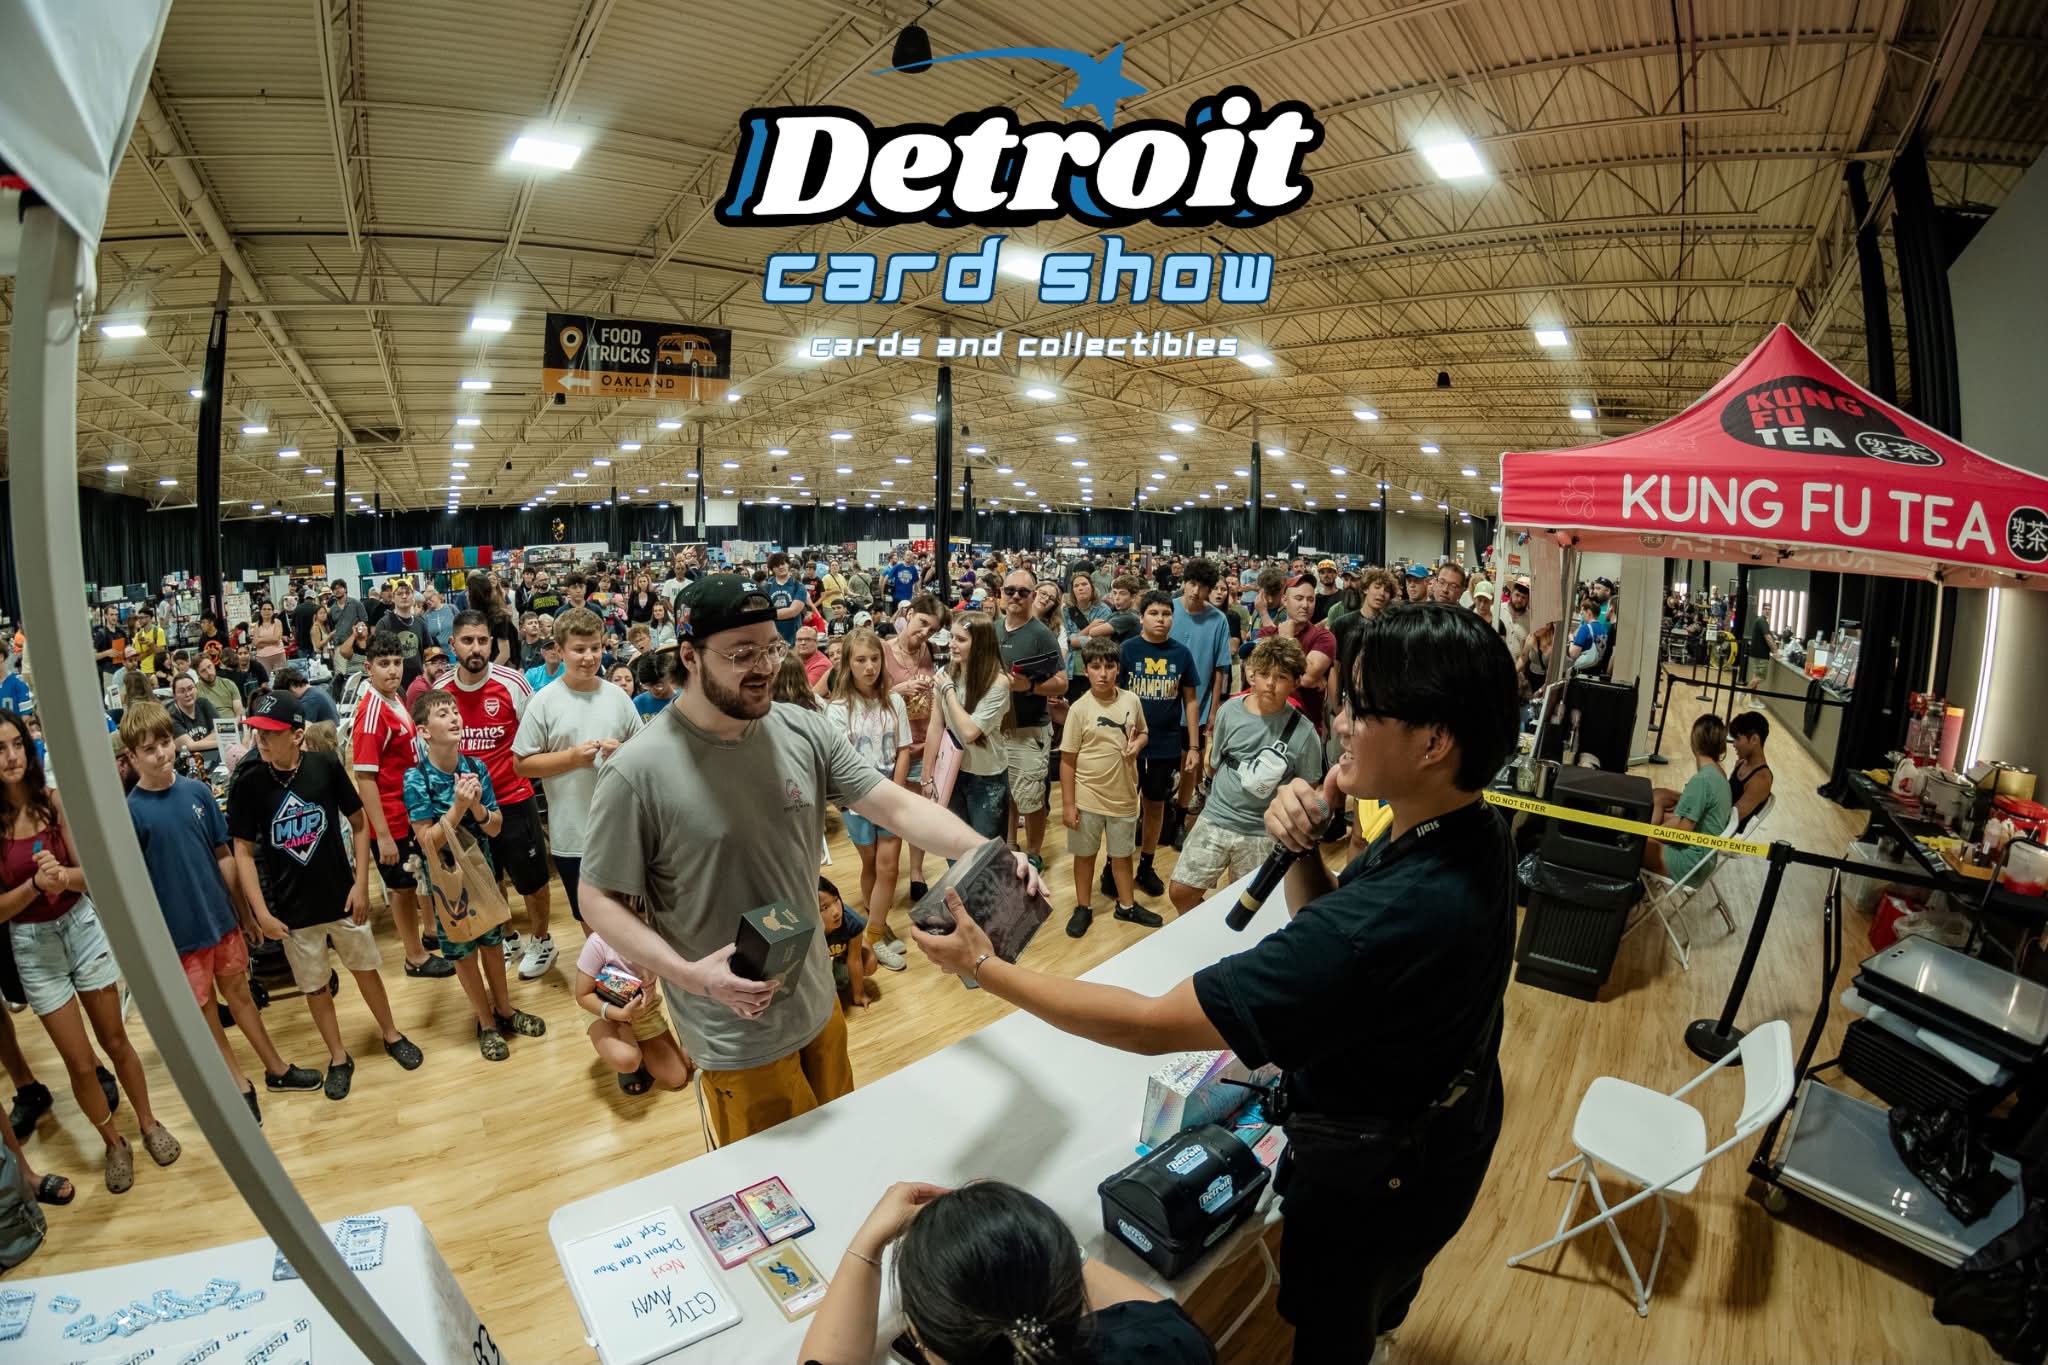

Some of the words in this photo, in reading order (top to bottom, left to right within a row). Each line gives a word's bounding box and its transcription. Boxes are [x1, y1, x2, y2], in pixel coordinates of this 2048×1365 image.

[601, 328, 643, 345] FOOD
[590, 344, 651, 364] TRUCKS
[601, 374, 675, 389] OAKLAND
[1746, 387, 1865, 417] KUNG
[1750, 406, 1807, 429] FU
[1755, 427, 1846, 449] TEA
[1621, 474, 1784, 528] KUNG
[1801, 482, 1871, 536] FU
[1888, 490, 1996, 555] TEA
[1144, 657, 1168, 675] M
[461, 725, 505, 739] irates
[1489, 794, 1501, 803] DO
[1502, 797, 1519, 806] NOT
[1519, 801, 1546, 813] ENTER
[284, 832, 317, 848] GAMES
[1653, 828, 1691, 842] CAUTION
[1696, 836, 1710, 845] DO
[1710, 839, 1728, 848] NOT
[1729, 842, 1758, 854] ENTER
[1169, 1144, 1203, 1171] Detroit
[1201, 1176, 1231, 1206] Detroit
[637, 1221, 667, 1239] Sept
[644, 1237, 686, 1260] Detroit
[592, 1262, 618, 1276] Show
[619, 1253, 642, 1269] Card
[650, 1258, 686, 1279] Next
[631, 1284, 672, 1319] AWAY
[665, 1290, 717, 1328] GIVE
